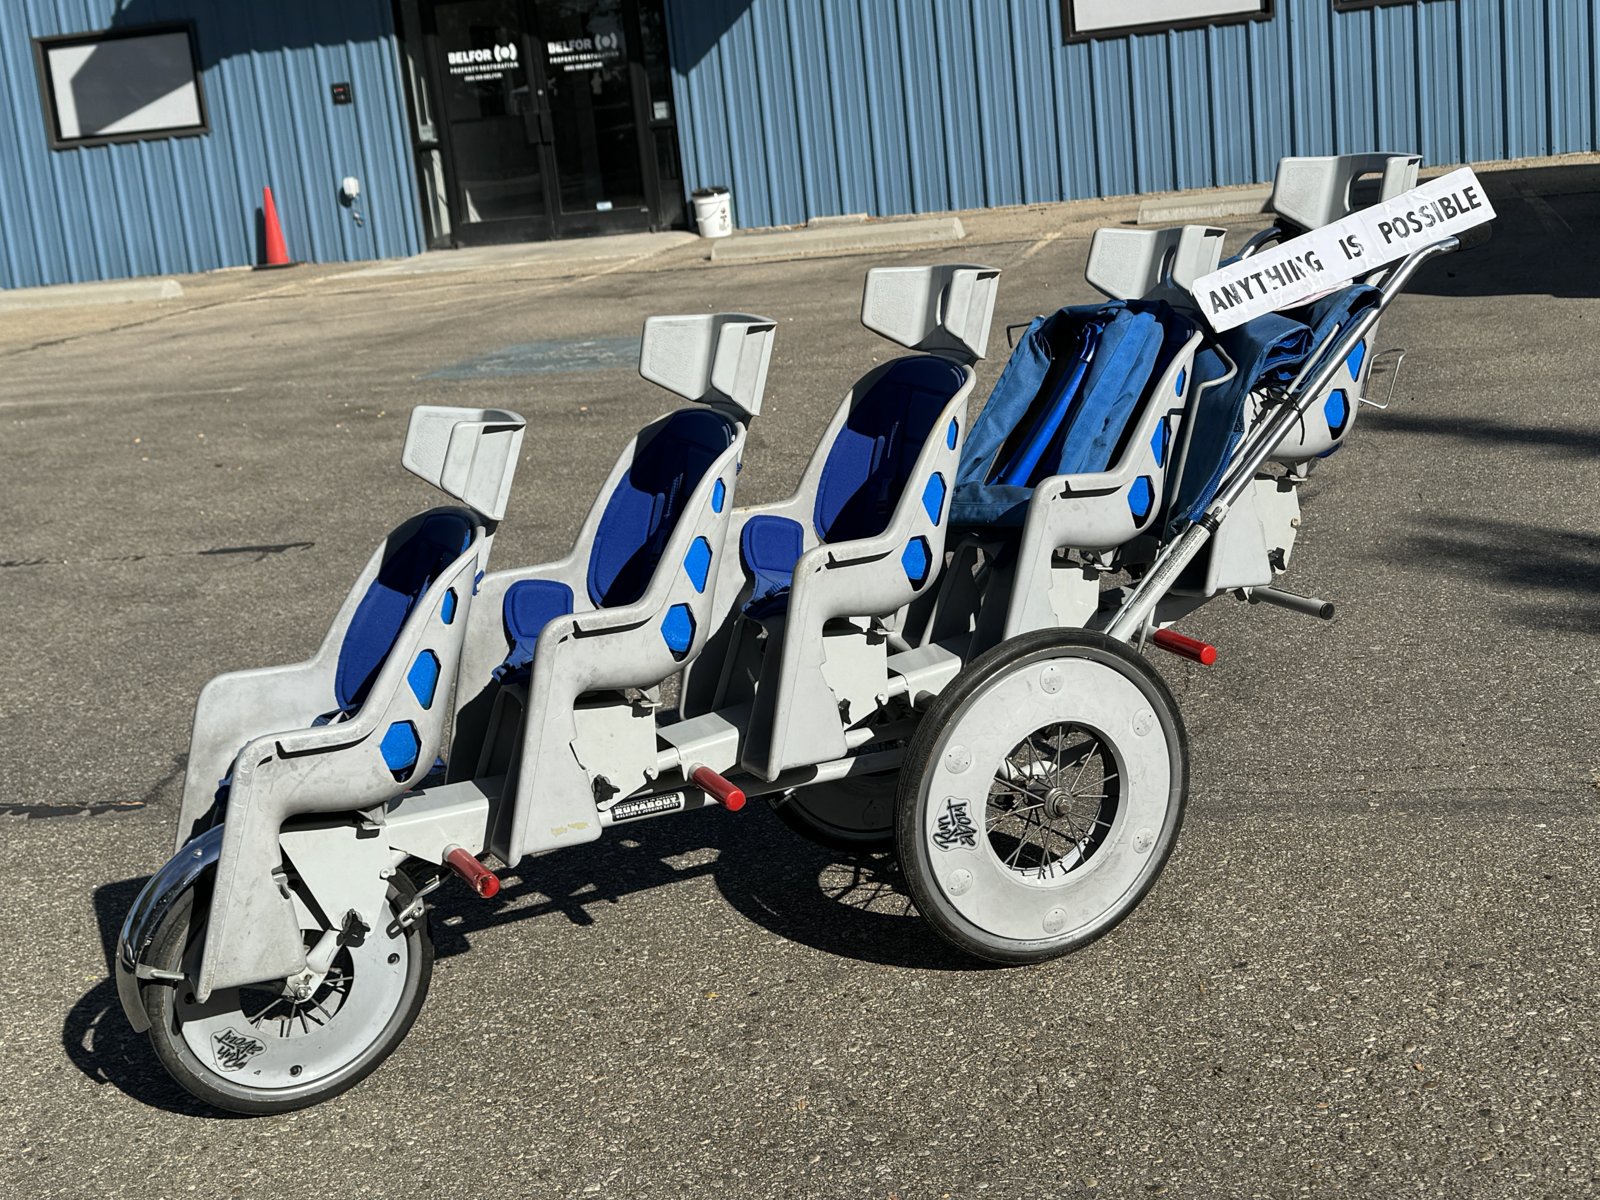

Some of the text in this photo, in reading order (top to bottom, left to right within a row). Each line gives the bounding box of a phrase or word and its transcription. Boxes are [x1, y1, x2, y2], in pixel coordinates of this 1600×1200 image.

[547, 38, 592, 54] BELFOR
[447, 48, 493, 65] BELFOR
[549, 54, 579, 64] PROPERTY
[449, 65, 479, 74] PROPERTY
[1208, 186, 1482, 315] ANYTHING IS POSSIBLE
[614, 796, 677, 815] RUNABOUT
[933, 814, 958, 849] Run
